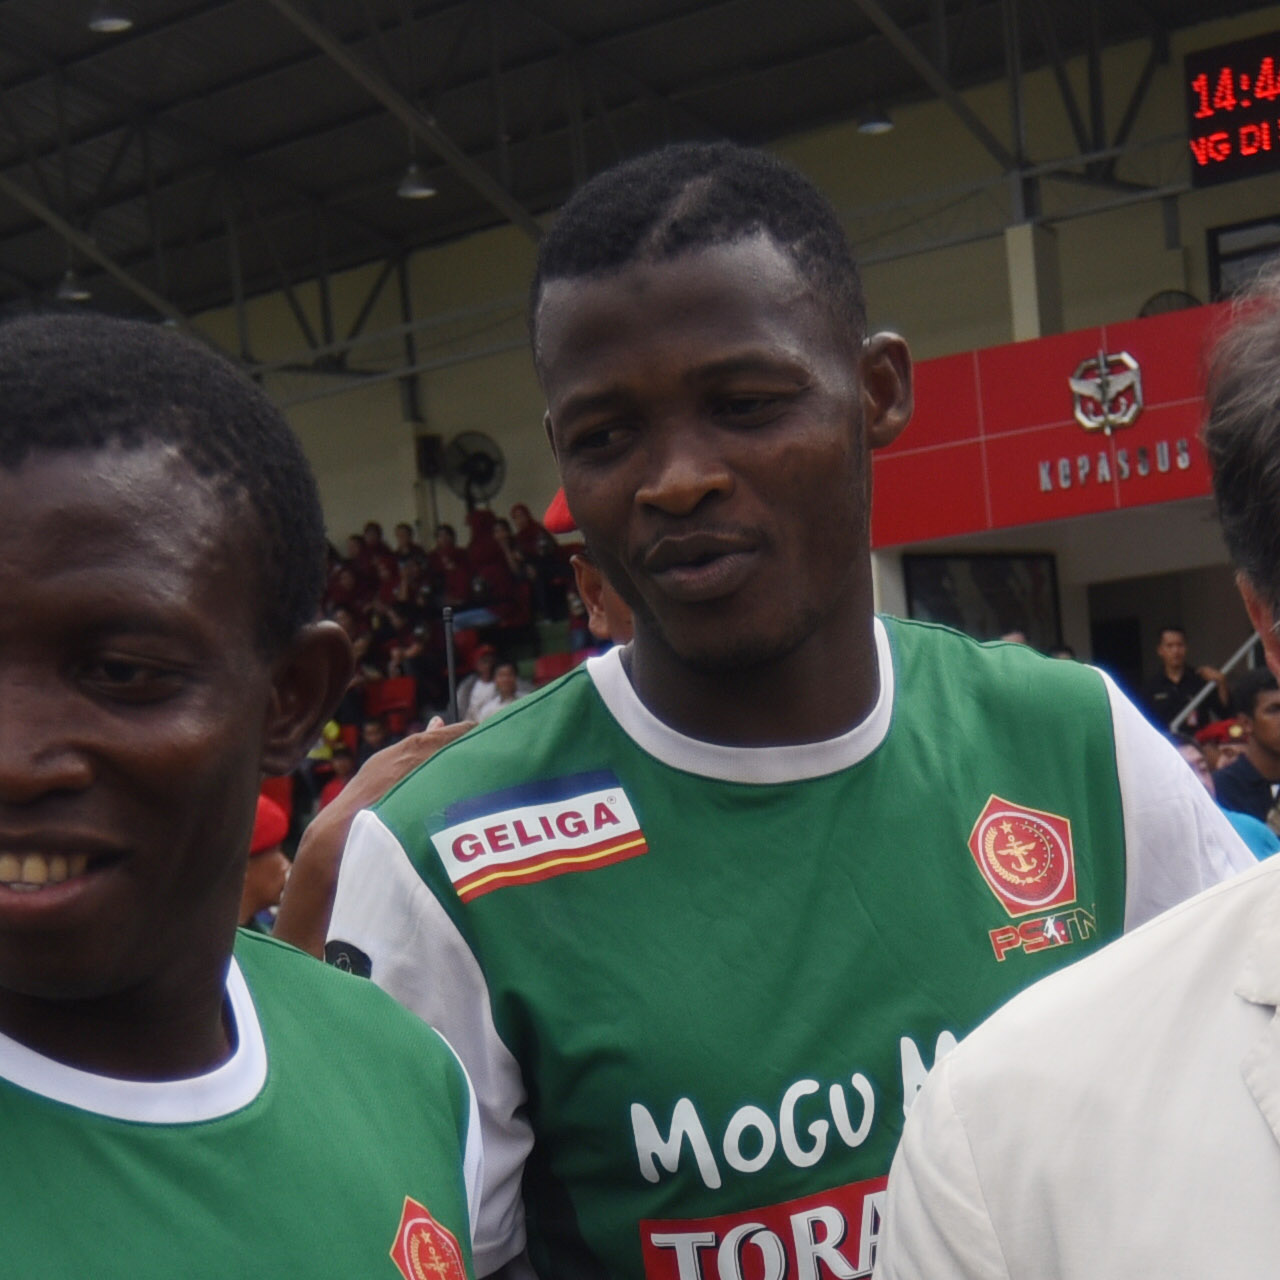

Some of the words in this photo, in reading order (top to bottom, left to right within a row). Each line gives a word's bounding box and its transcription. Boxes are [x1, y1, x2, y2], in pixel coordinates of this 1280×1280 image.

[1238, 121, 1271, 156] DI
[1039, 438, 1190, 492] KOPASSUS
[451, 802, 621, 863] GELIGA
